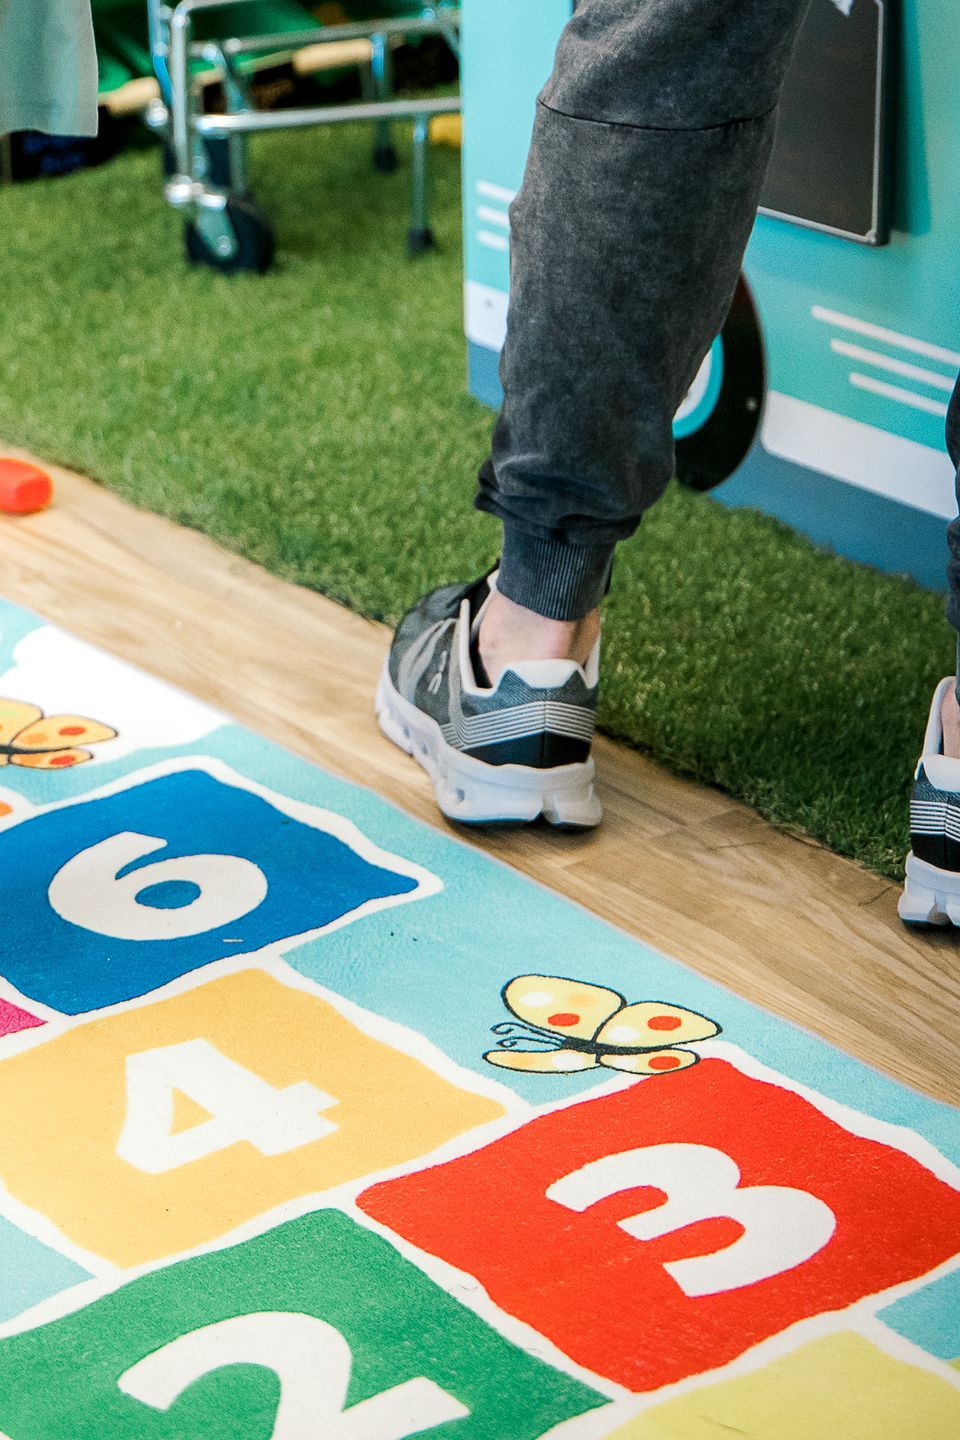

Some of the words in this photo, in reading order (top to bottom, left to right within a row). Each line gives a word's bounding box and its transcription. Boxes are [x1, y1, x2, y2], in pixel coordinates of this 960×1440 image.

[47, 831, 268, 941] 6
[114, 1037, 340, 1176] 4
[545, 1143, 836, 1298] 3
[116, 1310, 471, 1440] 2
